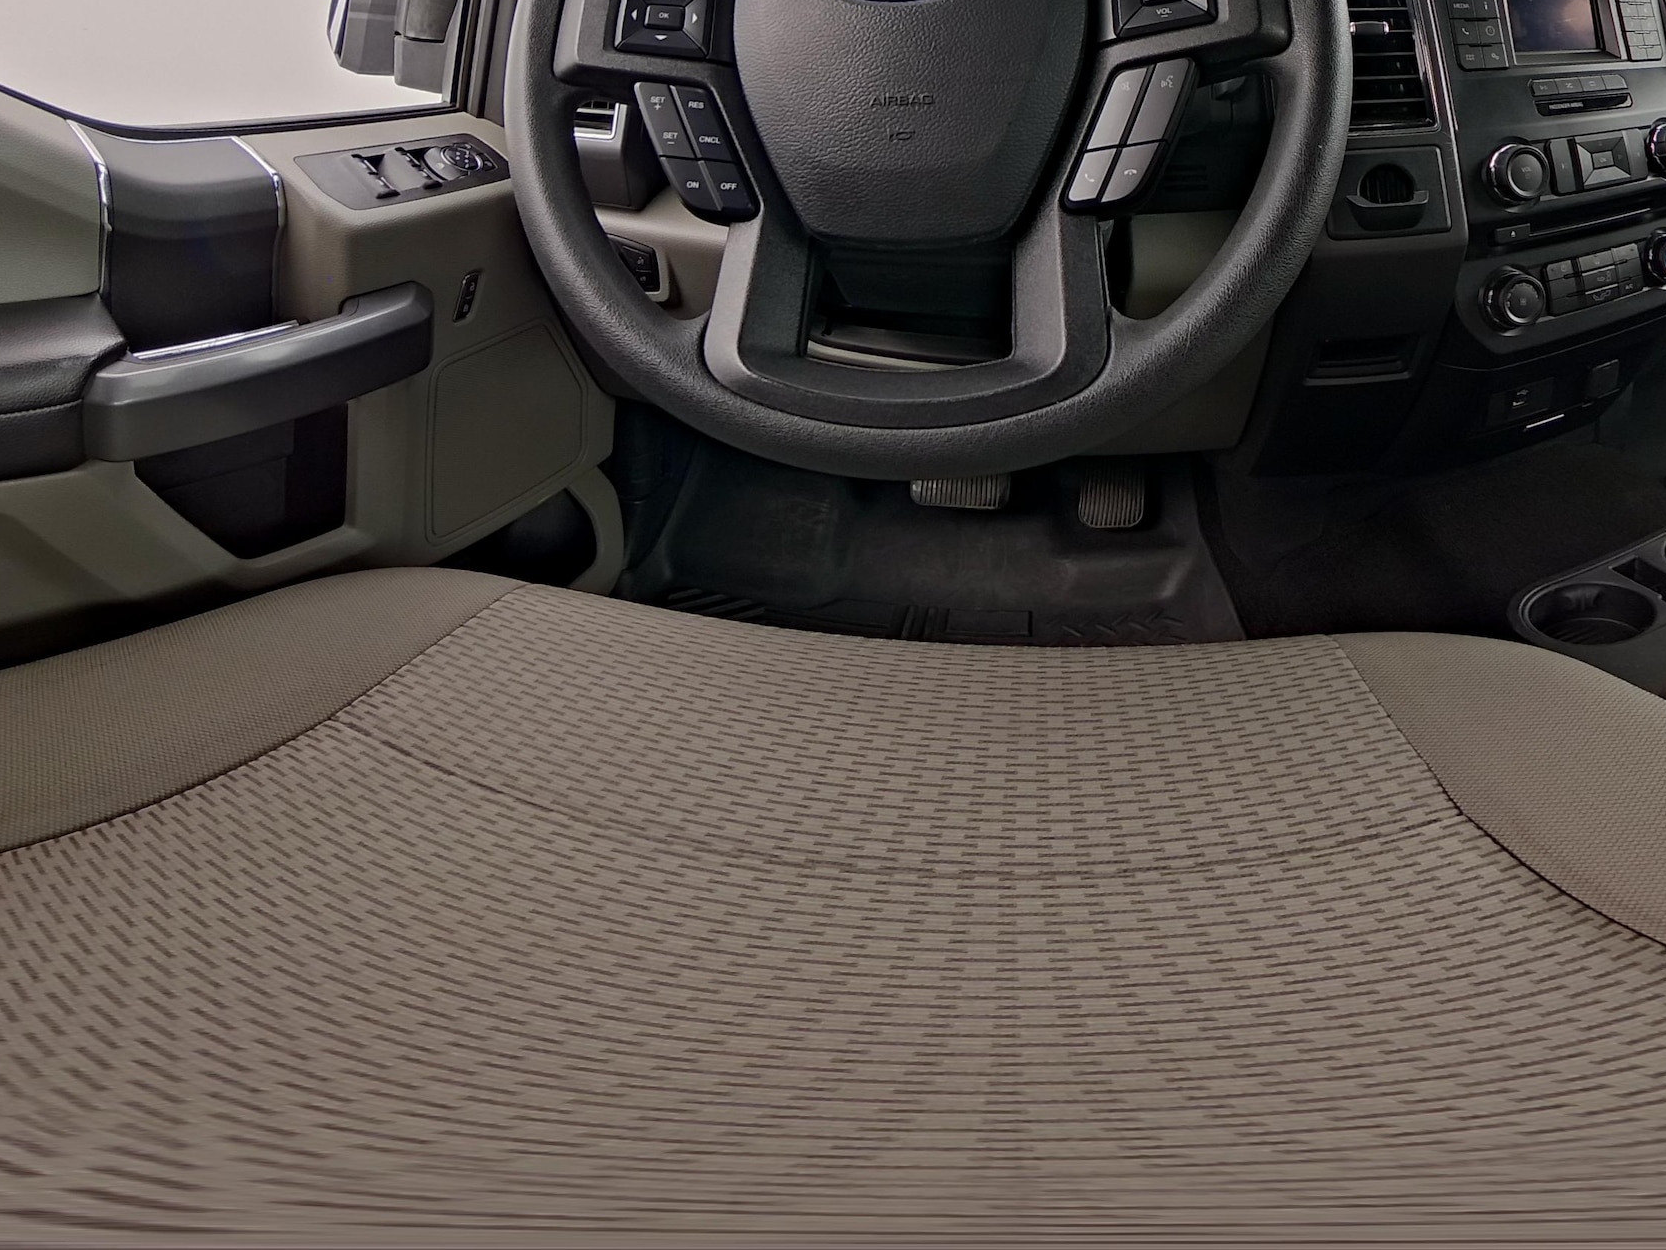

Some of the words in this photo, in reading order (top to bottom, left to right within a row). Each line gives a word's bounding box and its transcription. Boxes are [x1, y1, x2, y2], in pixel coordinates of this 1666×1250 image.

[1156, 7, 1172, 15] VOL
[650, 96, 666, 104] SET
[871, 94, 934, 107] AIRBAG
[688, 101, 704, 109] RES
[699, 135, 721, 144] CNCL
[686, 181, 700, 189] ON
[720, 182, 737, 190] OFF
